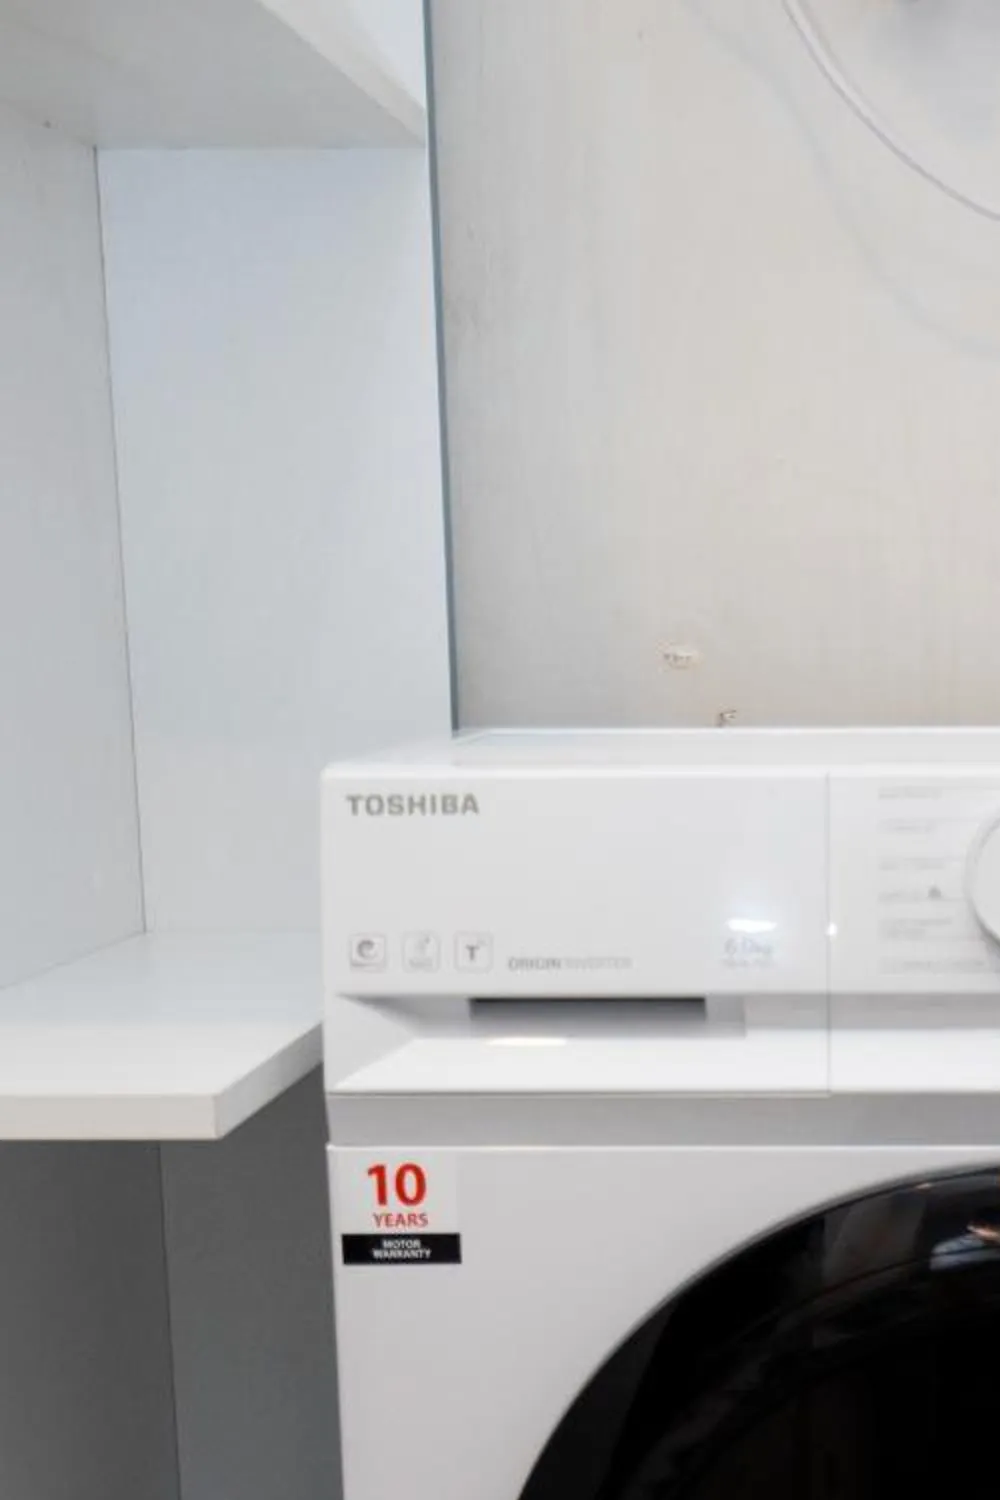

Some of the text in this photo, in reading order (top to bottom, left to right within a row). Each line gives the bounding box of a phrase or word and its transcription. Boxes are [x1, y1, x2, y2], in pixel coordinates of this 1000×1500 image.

[345, 792, 480, 817] TOSHIBA
[367, 1162, 427, 1207] 10
[372, 1212, 429, 1229] YEARS
[382, 1239, 421, 1249] MOTOR
[372, 1248, 432, 1260] WARRANTY
